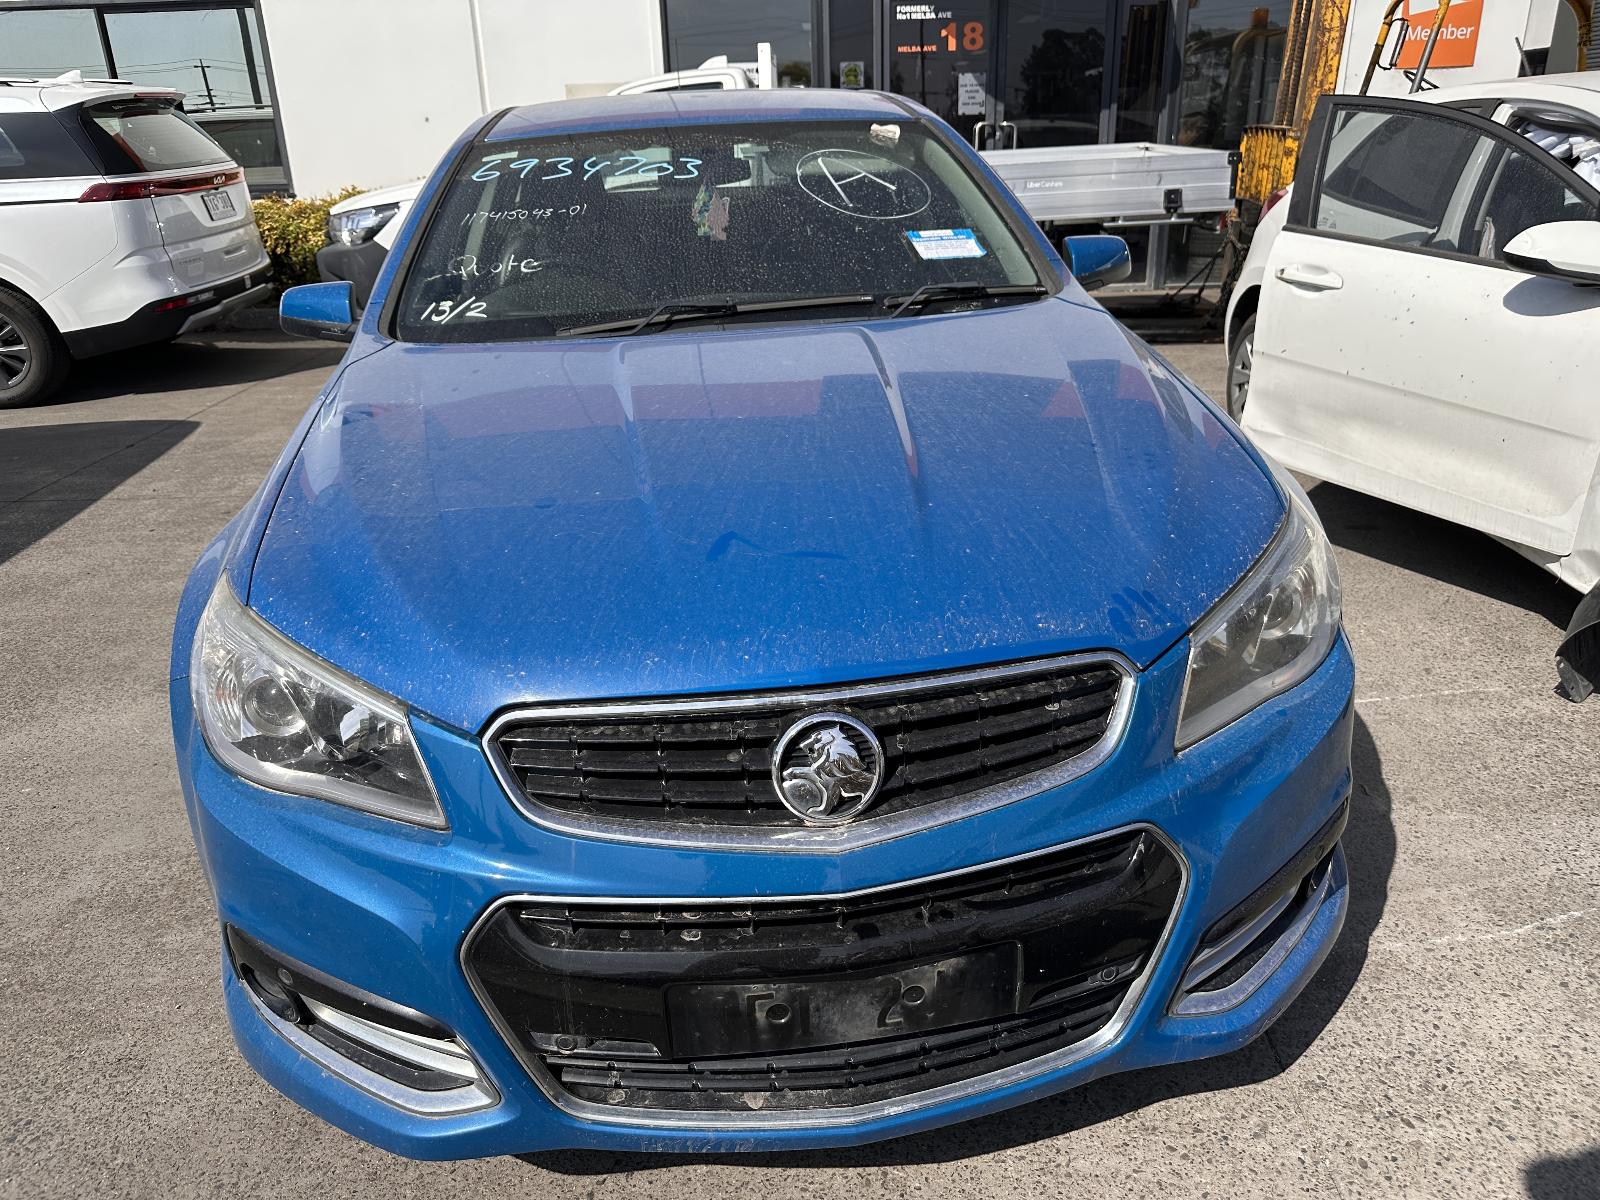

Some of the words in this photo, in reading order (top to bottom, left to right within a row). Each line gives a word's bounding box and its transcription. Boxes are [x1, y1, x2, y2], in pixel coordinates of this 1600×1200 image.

[937, 11, 952, 19] AVE
[940, 21, 984, 52] 18
[420, 296, 488, 325] 13/2
